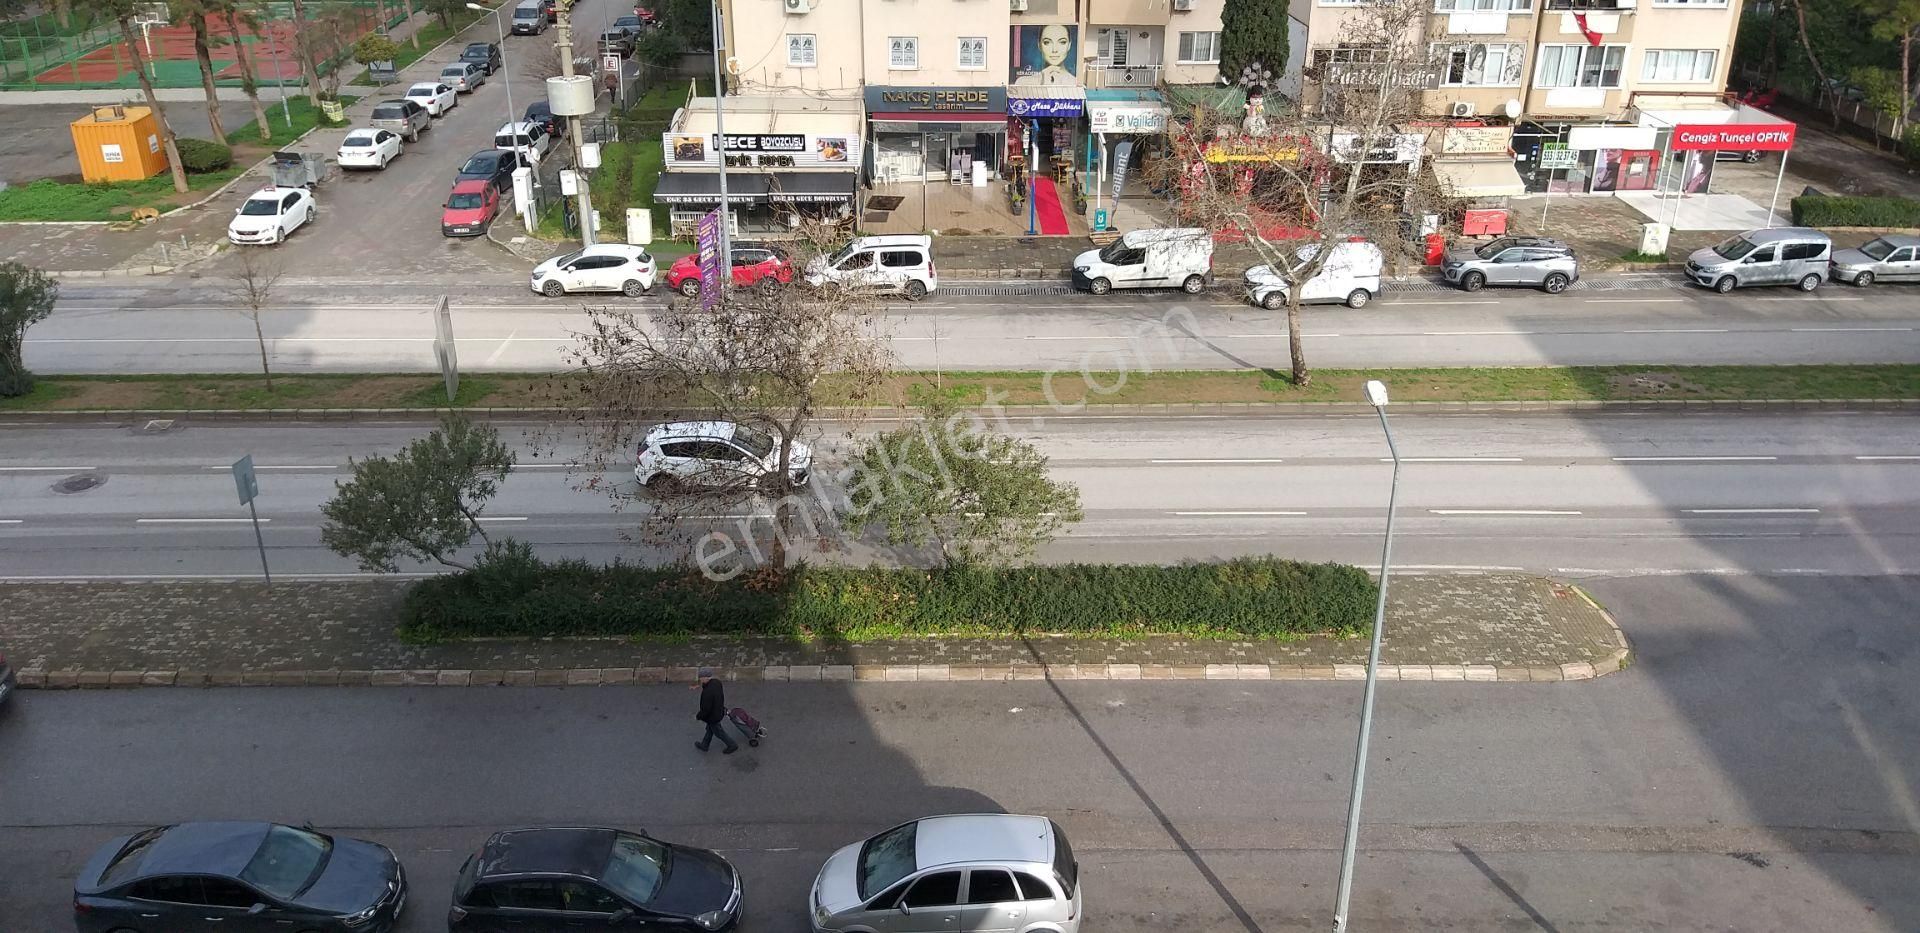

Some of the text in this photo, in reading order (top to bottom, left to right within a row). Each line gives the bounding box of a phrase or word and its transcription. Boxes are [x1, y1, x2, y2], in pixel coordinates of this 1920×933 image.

[882, 90, 989, 105] NAKIŞ PERDE
[760, 136, 804, 147] BOYOZCUSU
[1680, 130, 1790, 144] Cengiz Tunçel OPTİK
[757, 154, 796, 166] BOMBA
